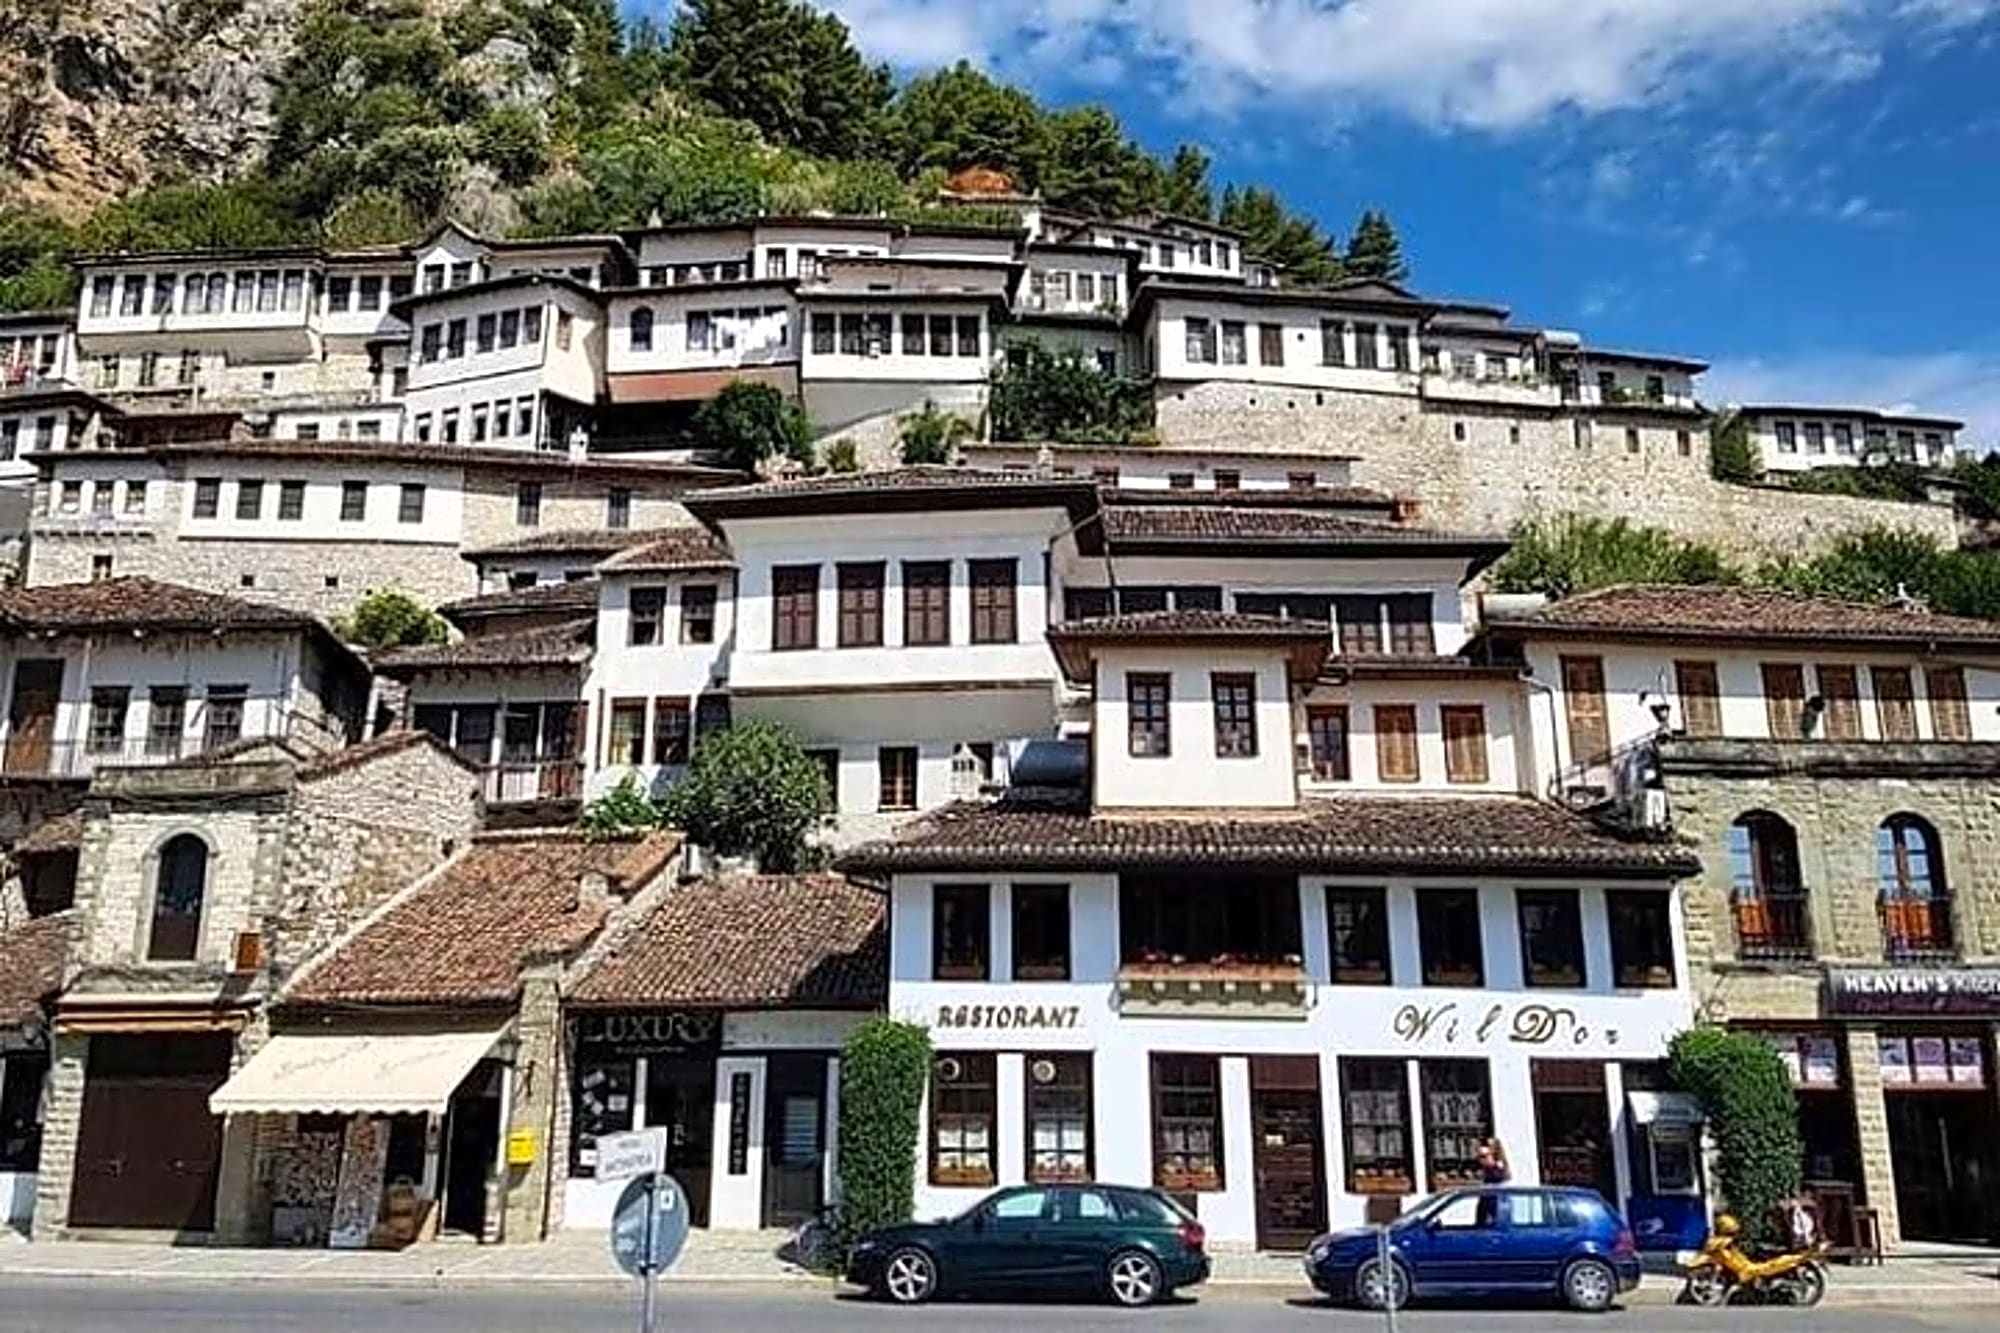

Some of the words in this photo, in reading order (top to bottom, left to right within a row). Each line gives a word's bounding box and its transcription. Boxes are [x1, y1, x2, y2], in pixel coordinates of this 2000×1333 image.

[1843, 975, 1949, 993] HEAVEN'S
[582, 1012, 715, 1043] LUXURY
[937, 1004, 1081, 1029] RESTORANT
